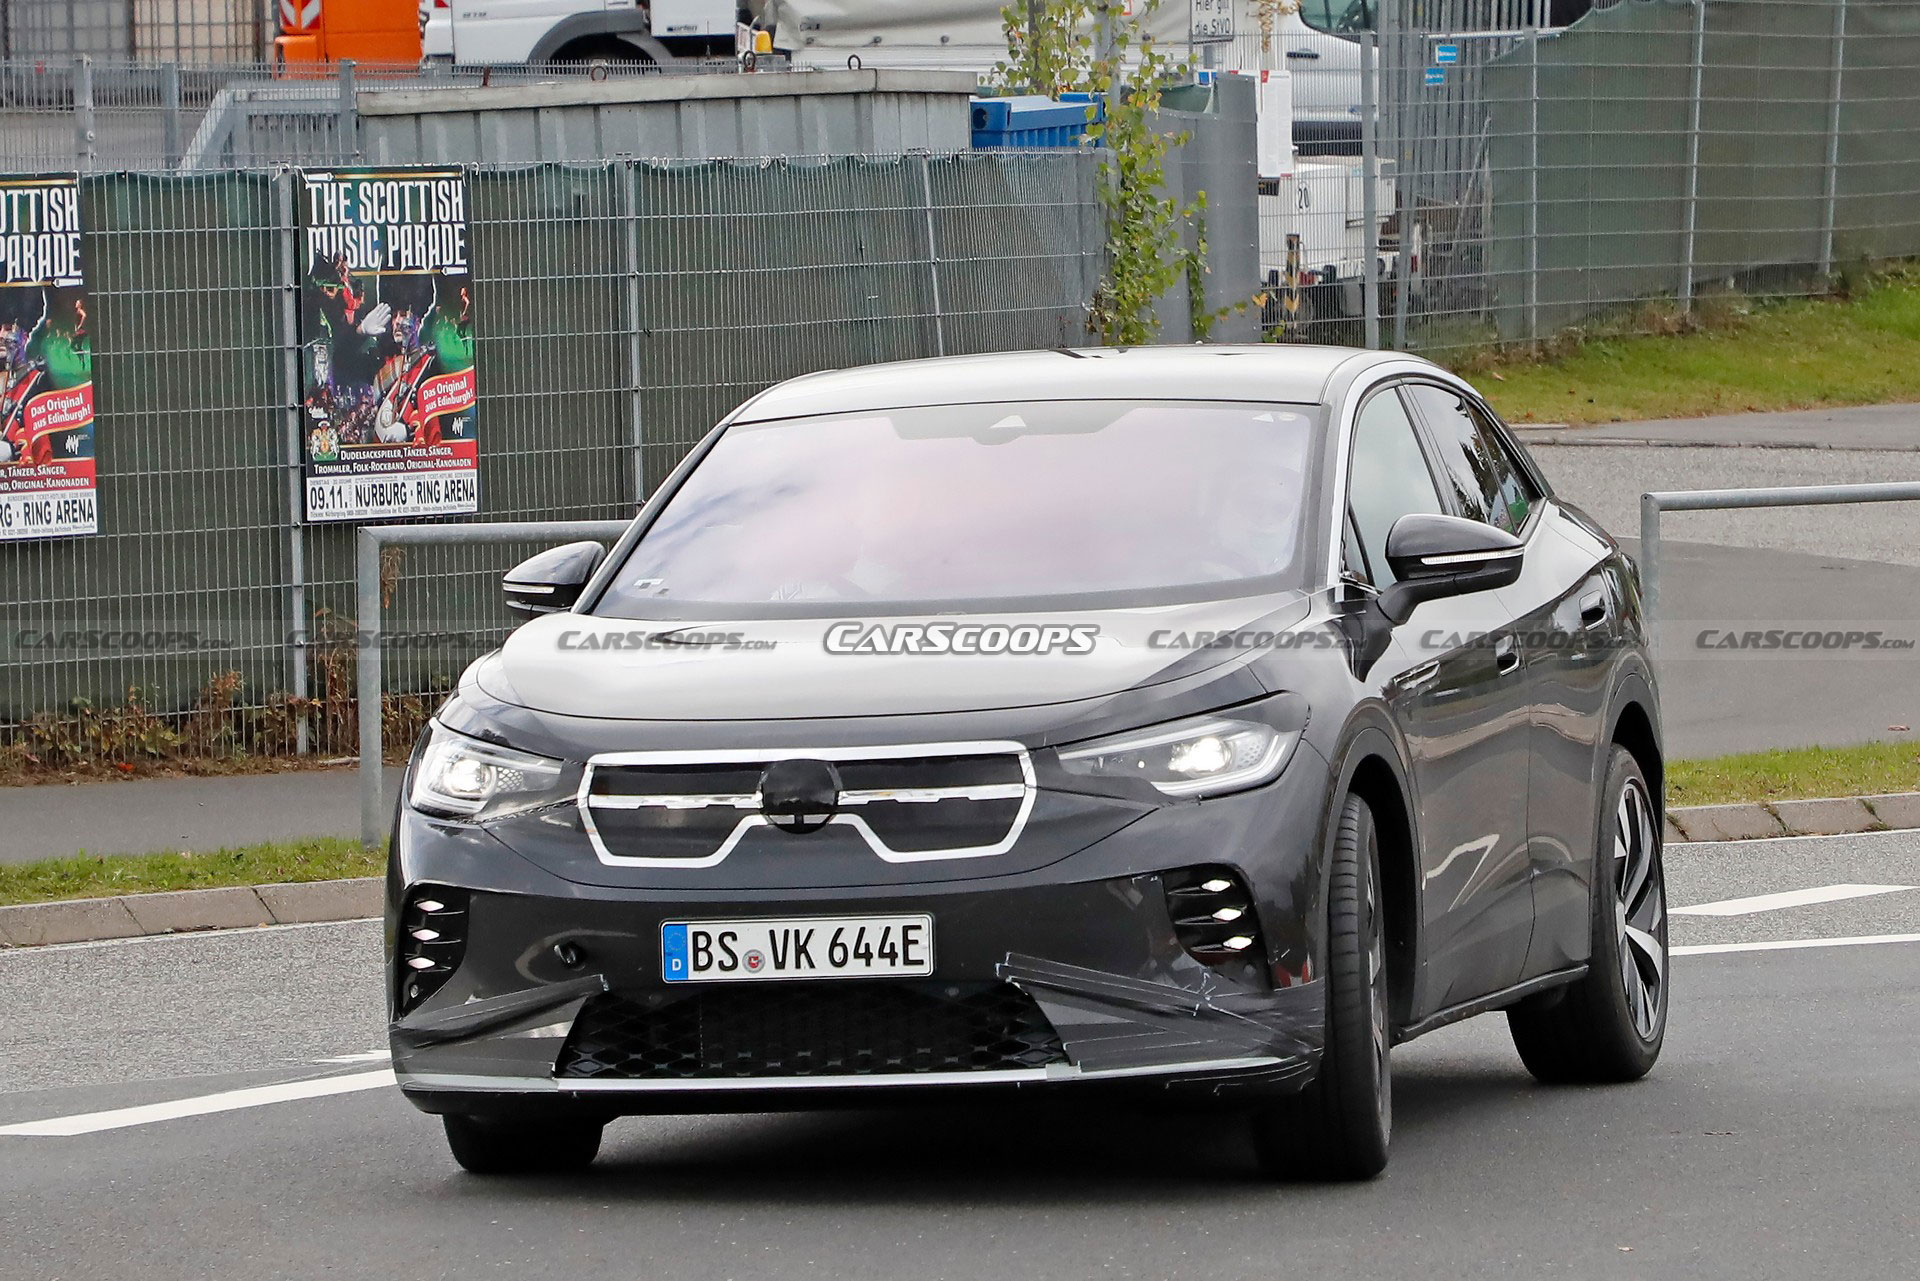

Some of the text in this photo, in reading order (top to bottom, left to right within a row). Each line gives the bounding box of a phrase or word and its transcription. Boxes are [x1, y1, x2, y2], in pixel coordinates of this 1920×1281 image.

[305, 180, 464, 225] THE SCOTTISH
[1298, 187, 1310, 209] 20
[306, 223, 467, 275] MUSIC PARADE
[423, 376, 467, 401] Das Original
[425, 388, 474, 413] aus Edinburgh!
[31, 392, 84, 418] Das Original
[33, 404, 91, 431] aus Edinburgh!
[310, 486, 348, 510] 09.11.
[355, 482, 407, 507] NÜRBURG
[416, 480, 440, 504] RING
[444, 478, 475, 503] ARENA
[23, 500, 52, 526] RING
[56, 498, 94, 524] ARENA
[691, 924, 925, 972] BS VK 644E
[671, 958, 682, 971] D
